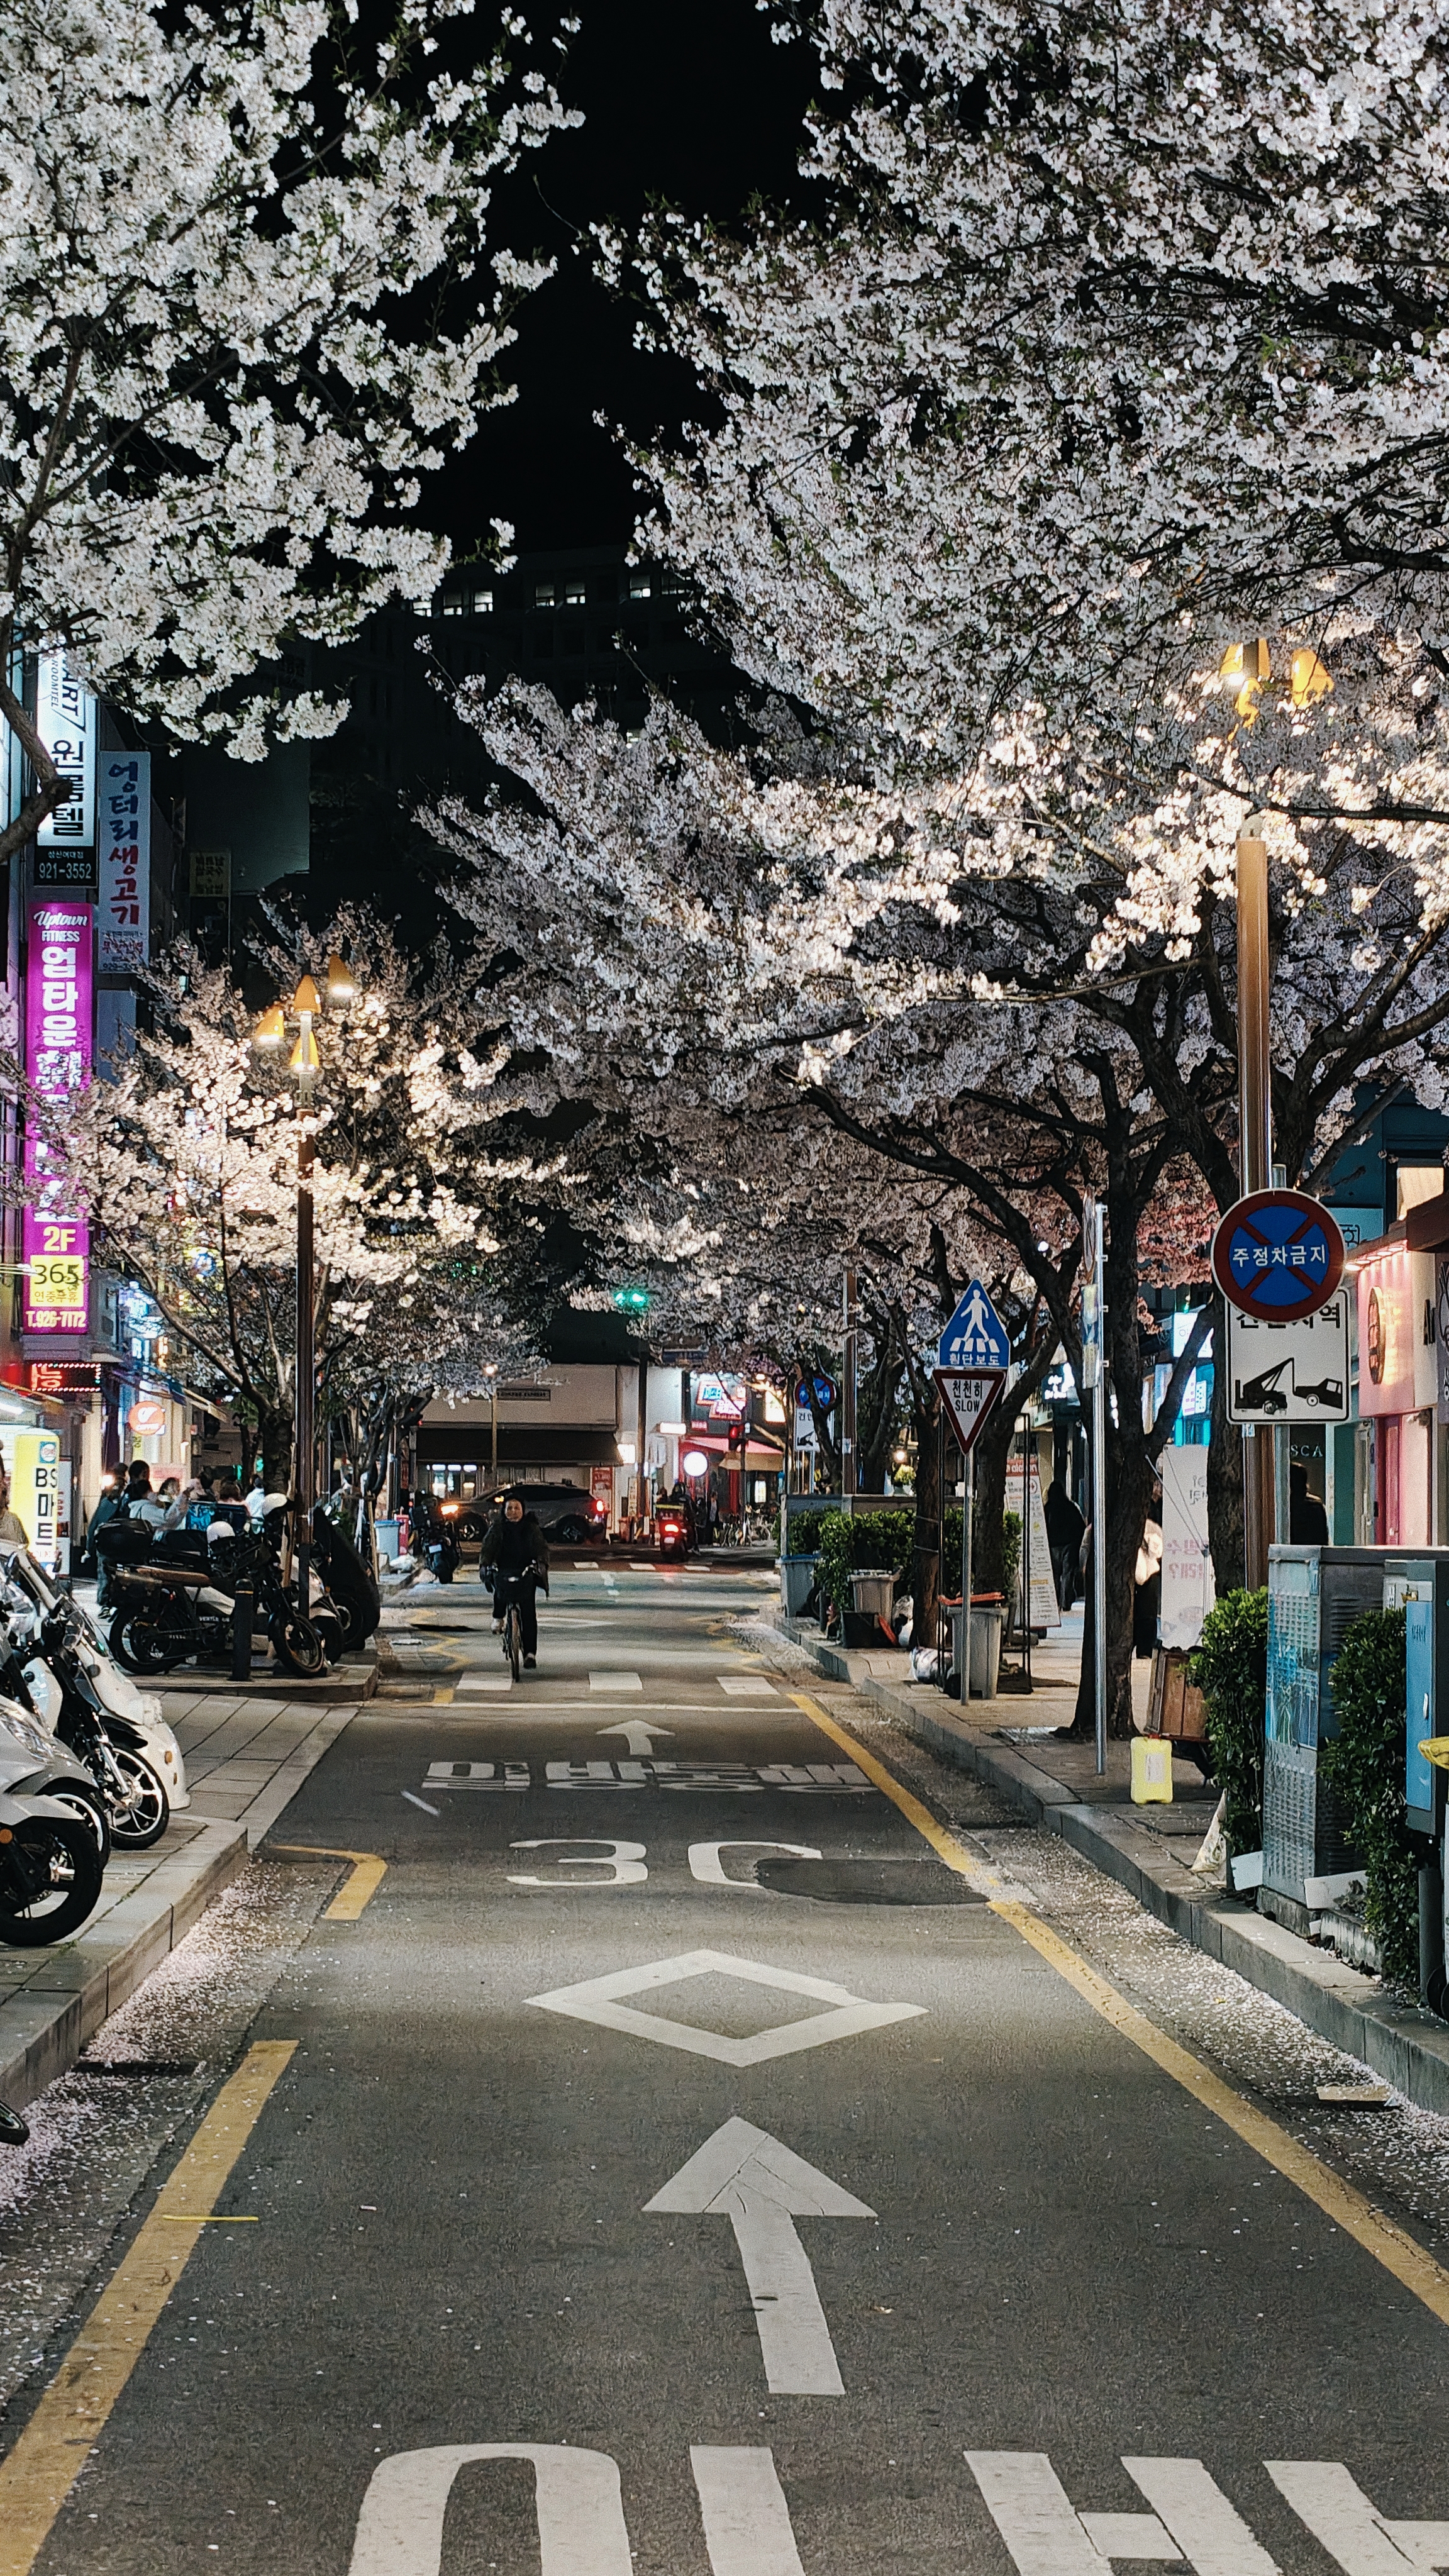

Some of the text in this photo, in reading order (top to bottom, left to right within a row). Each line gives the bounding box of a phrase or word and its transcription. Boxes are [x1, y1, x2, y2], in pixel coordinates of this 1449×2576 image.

[39, 862, 92, 879] 921-3552
[33, 911, 89, 930] Uptown
[42, 930, 80, 943] FITNESS
[42, 947, 79, 1047] 업타운
[43, 1226, 76, 1252] 2F
[1233, 1244, 1326, 1267] 주정차금지
[34, 1263, 80, 1285] 365
[34, 1291, 78, 1302] 연중무휴
[950, 1352, 1000, 1366] 횡단보도
[953, 1380, 982, 1400] 천천히
[955, 1399, 980, 1413] SLOW
[35, 1467, 57, 1487] BS
